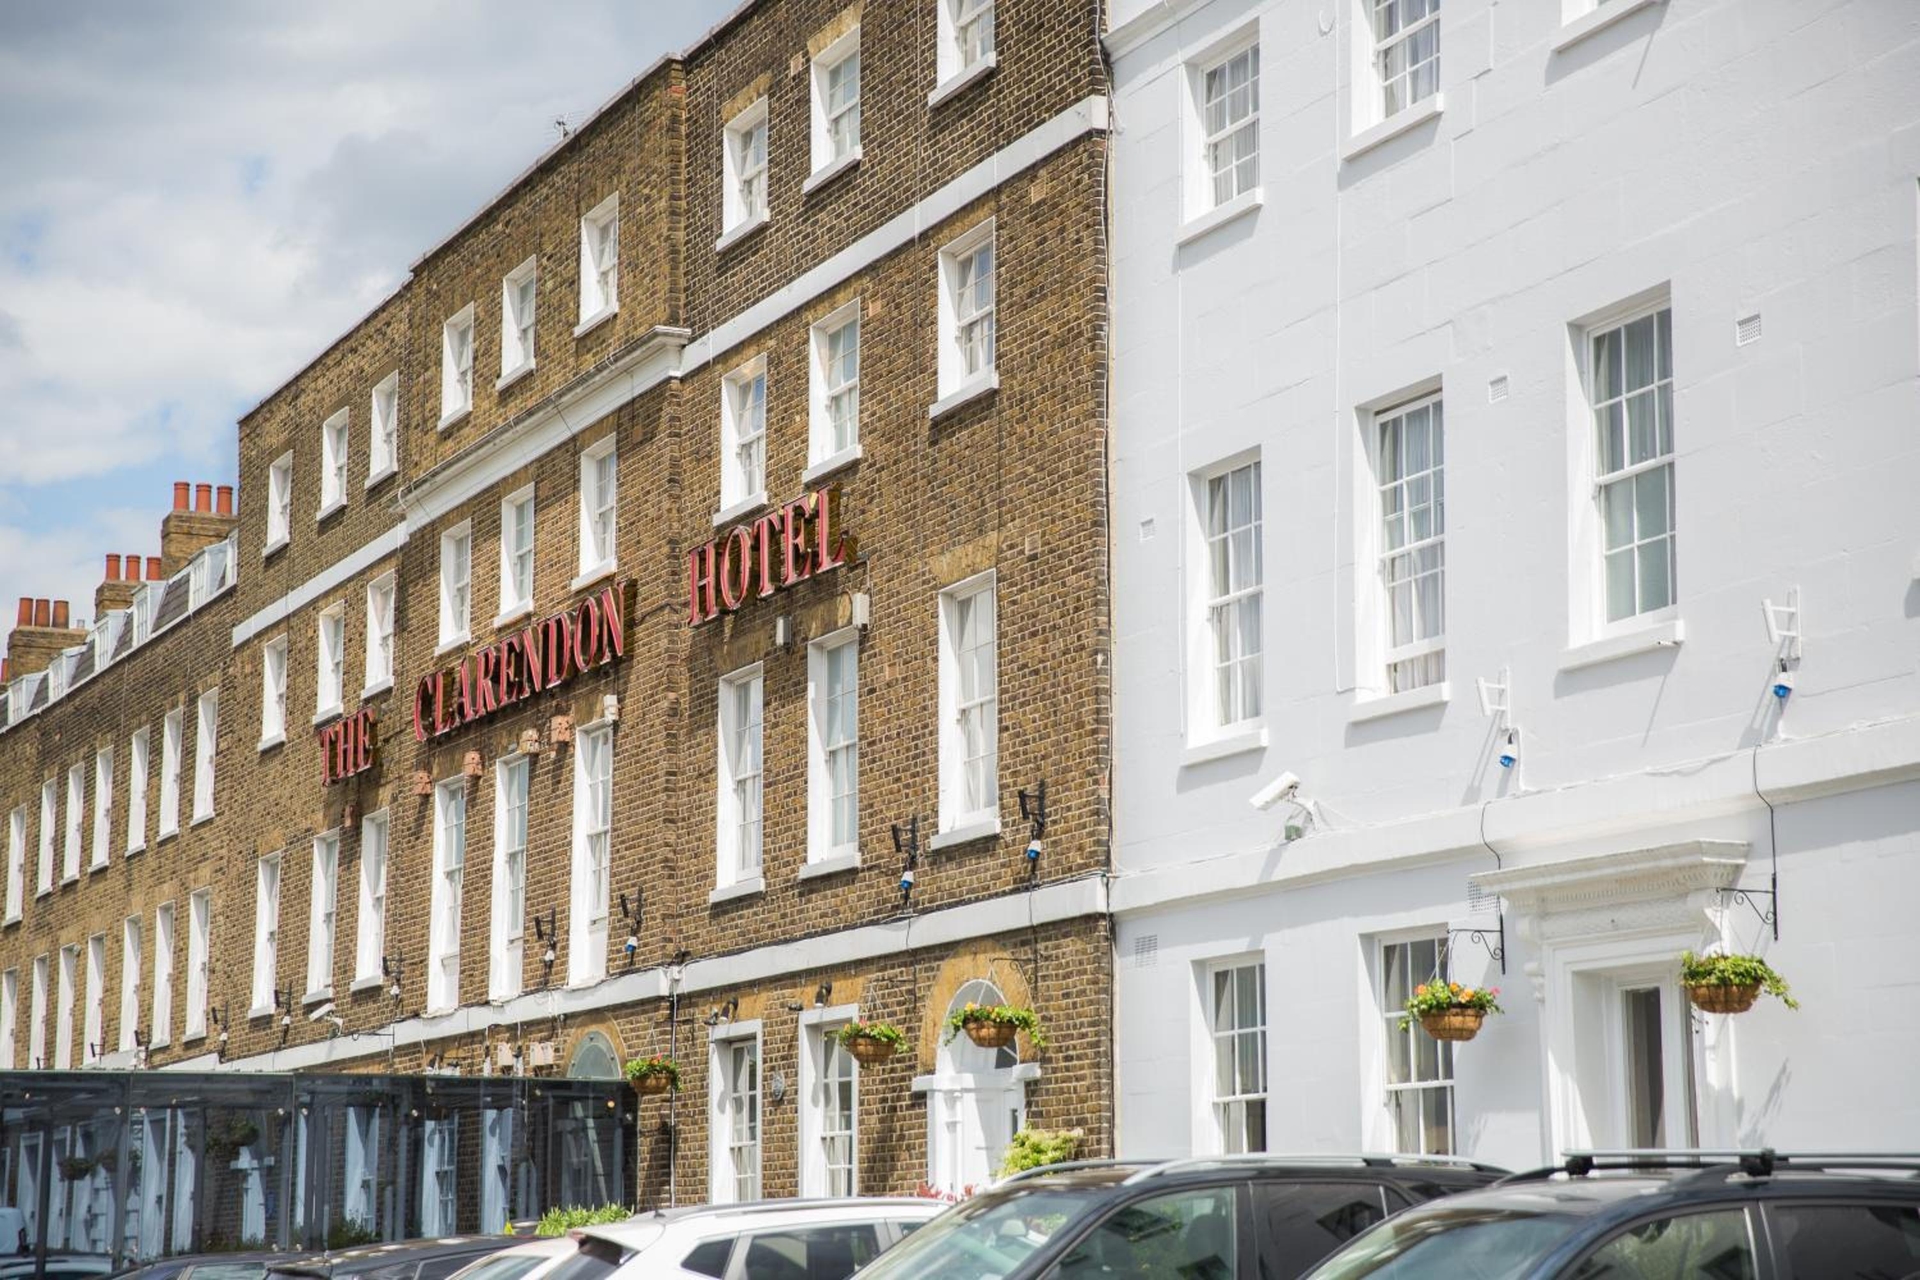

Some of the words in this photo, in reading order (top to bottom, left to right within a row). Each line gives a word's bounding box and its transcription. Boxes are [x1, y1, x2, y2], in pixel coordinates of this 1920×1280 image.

[321, 705, 376, 786] THE
[413, 579, 627, 742] CLARENDON
[687, 484, 849, 627] HOTEL
